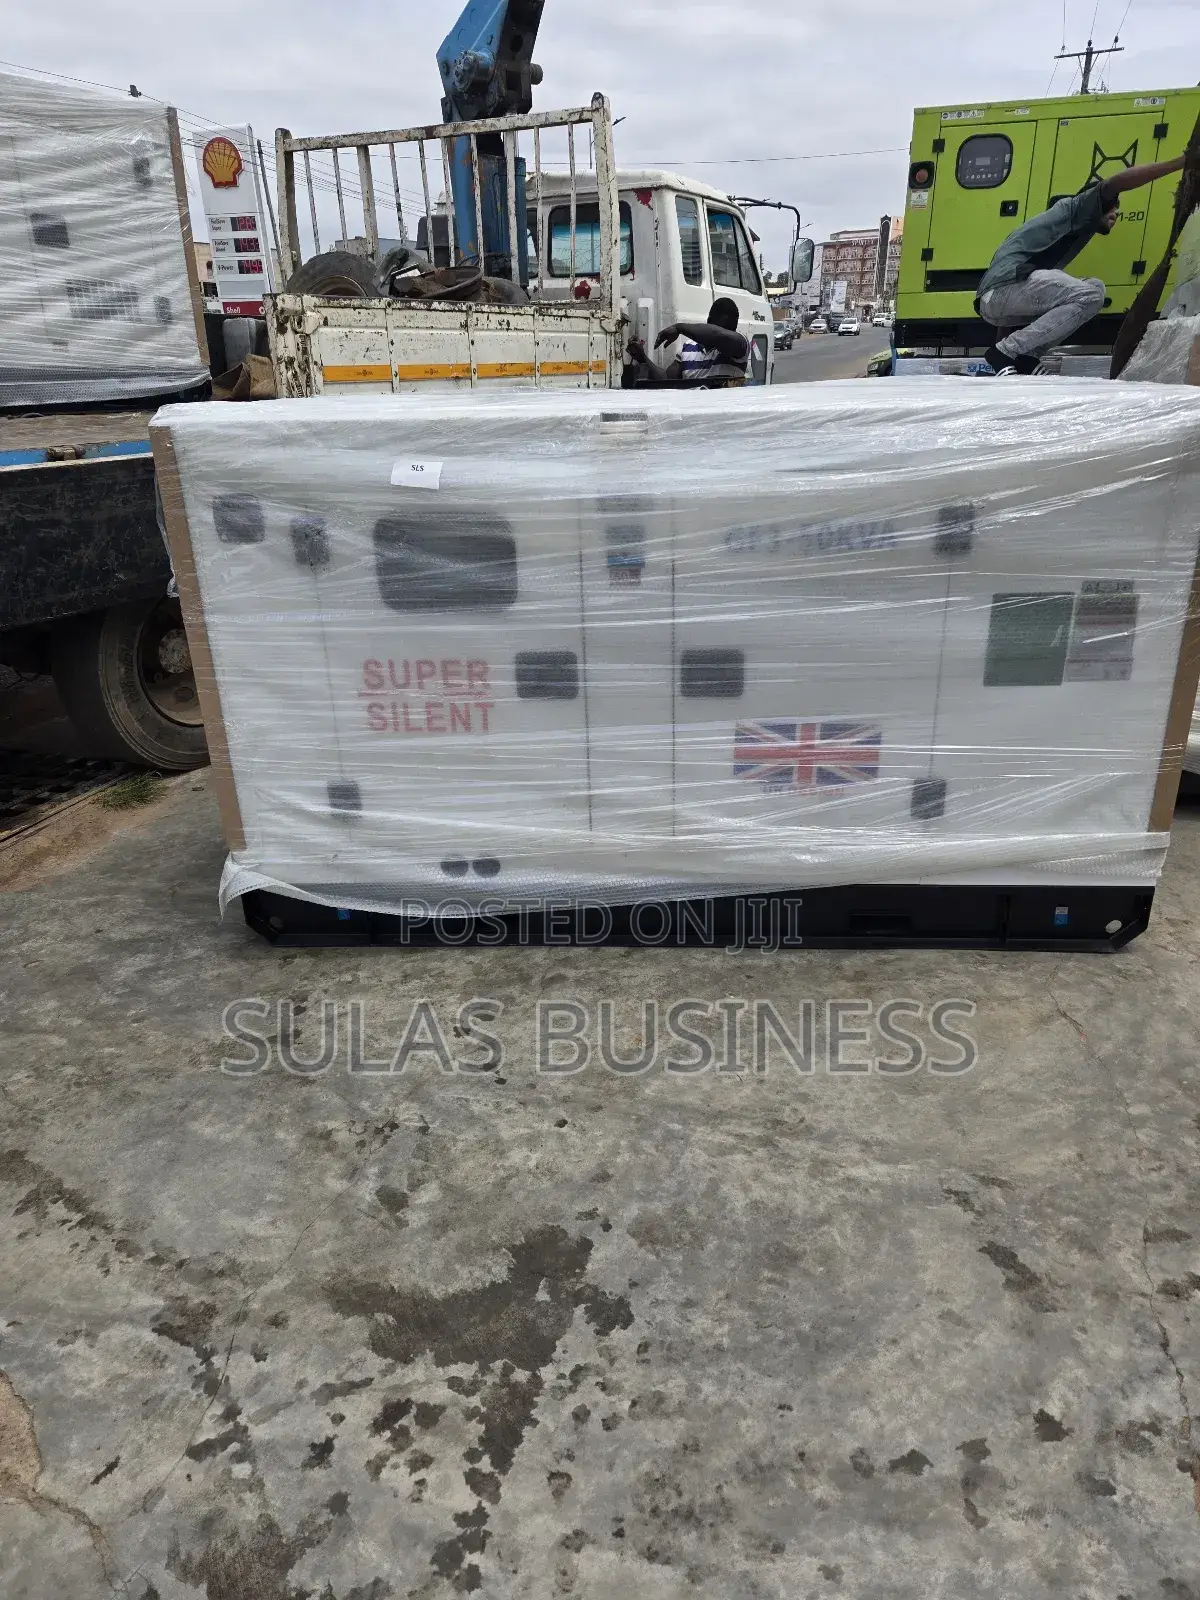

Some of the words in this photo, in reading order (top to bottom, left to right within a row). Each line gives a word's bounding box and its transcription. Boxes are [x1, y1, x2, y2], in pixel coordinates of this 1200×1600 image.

[226, 306, 241, 314] Shell
[410, 464, 425, 472] SLS
[363, 658, 490, 689] SUPER
[366, 700, 495, 732] SILENT
